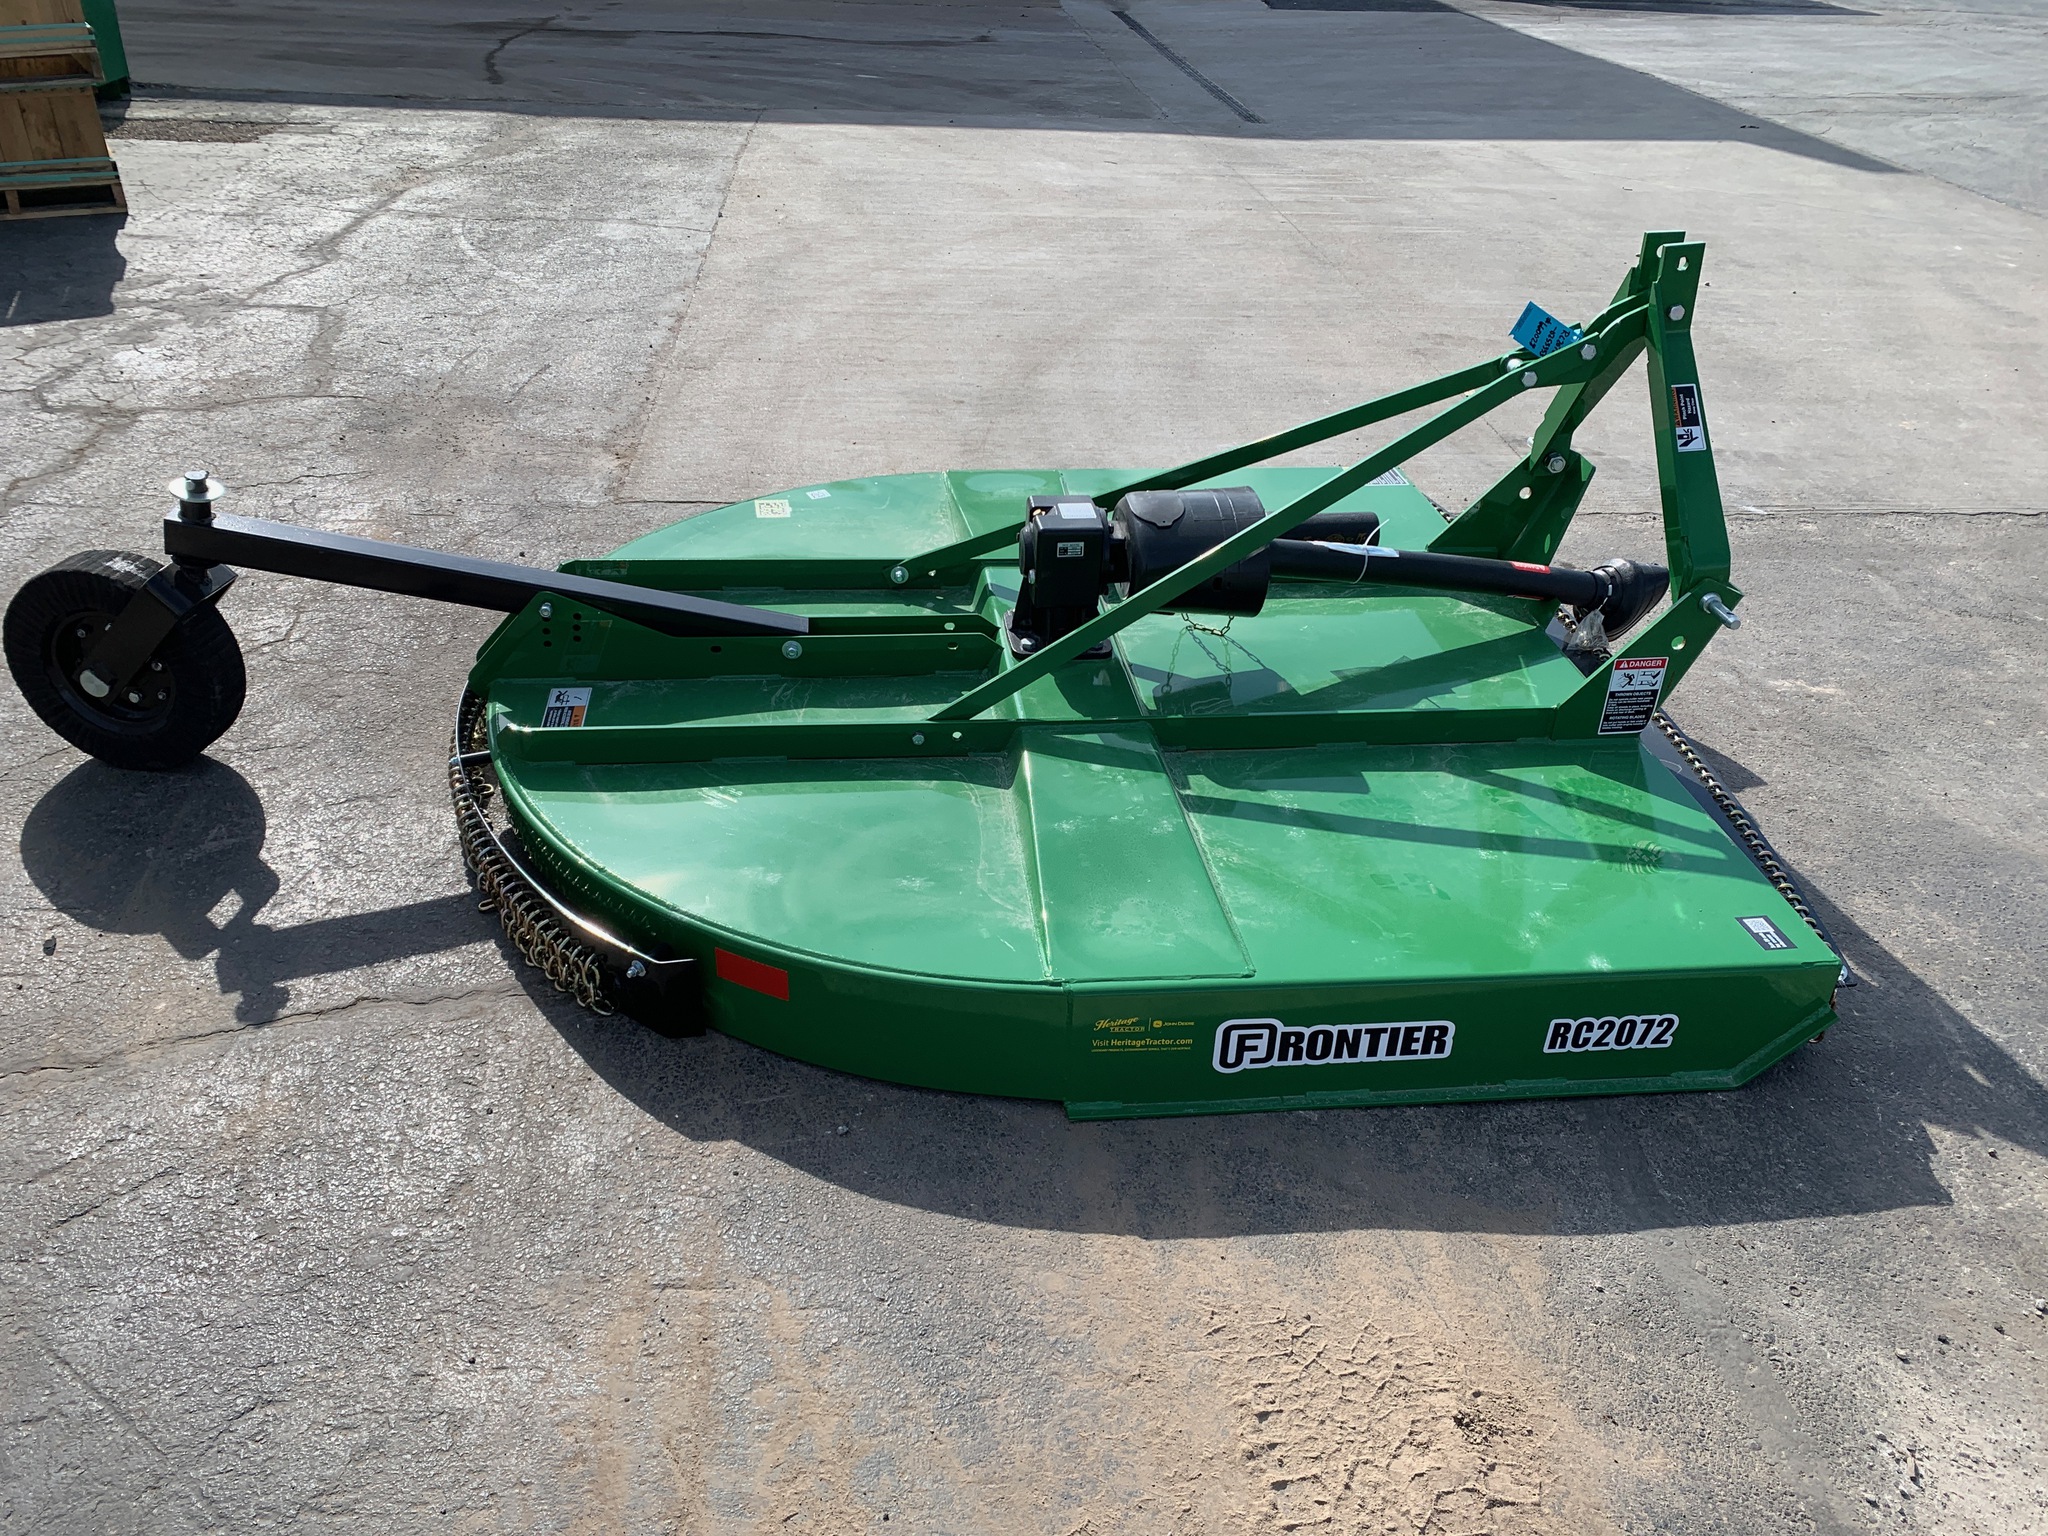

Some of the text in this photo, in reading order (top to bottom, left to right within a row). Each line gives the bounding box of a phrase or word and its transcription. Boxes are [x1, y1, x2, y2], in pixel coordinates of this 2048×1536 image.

[1093, 1017, 1139, 1031] Heritage
[1546, 1016, 1677, 1050] RC2072
[1092, 1038, 1193, 1047] Visit HeritageTractor.com
[1216, 1020, 1452, 1070] FRONTIER
